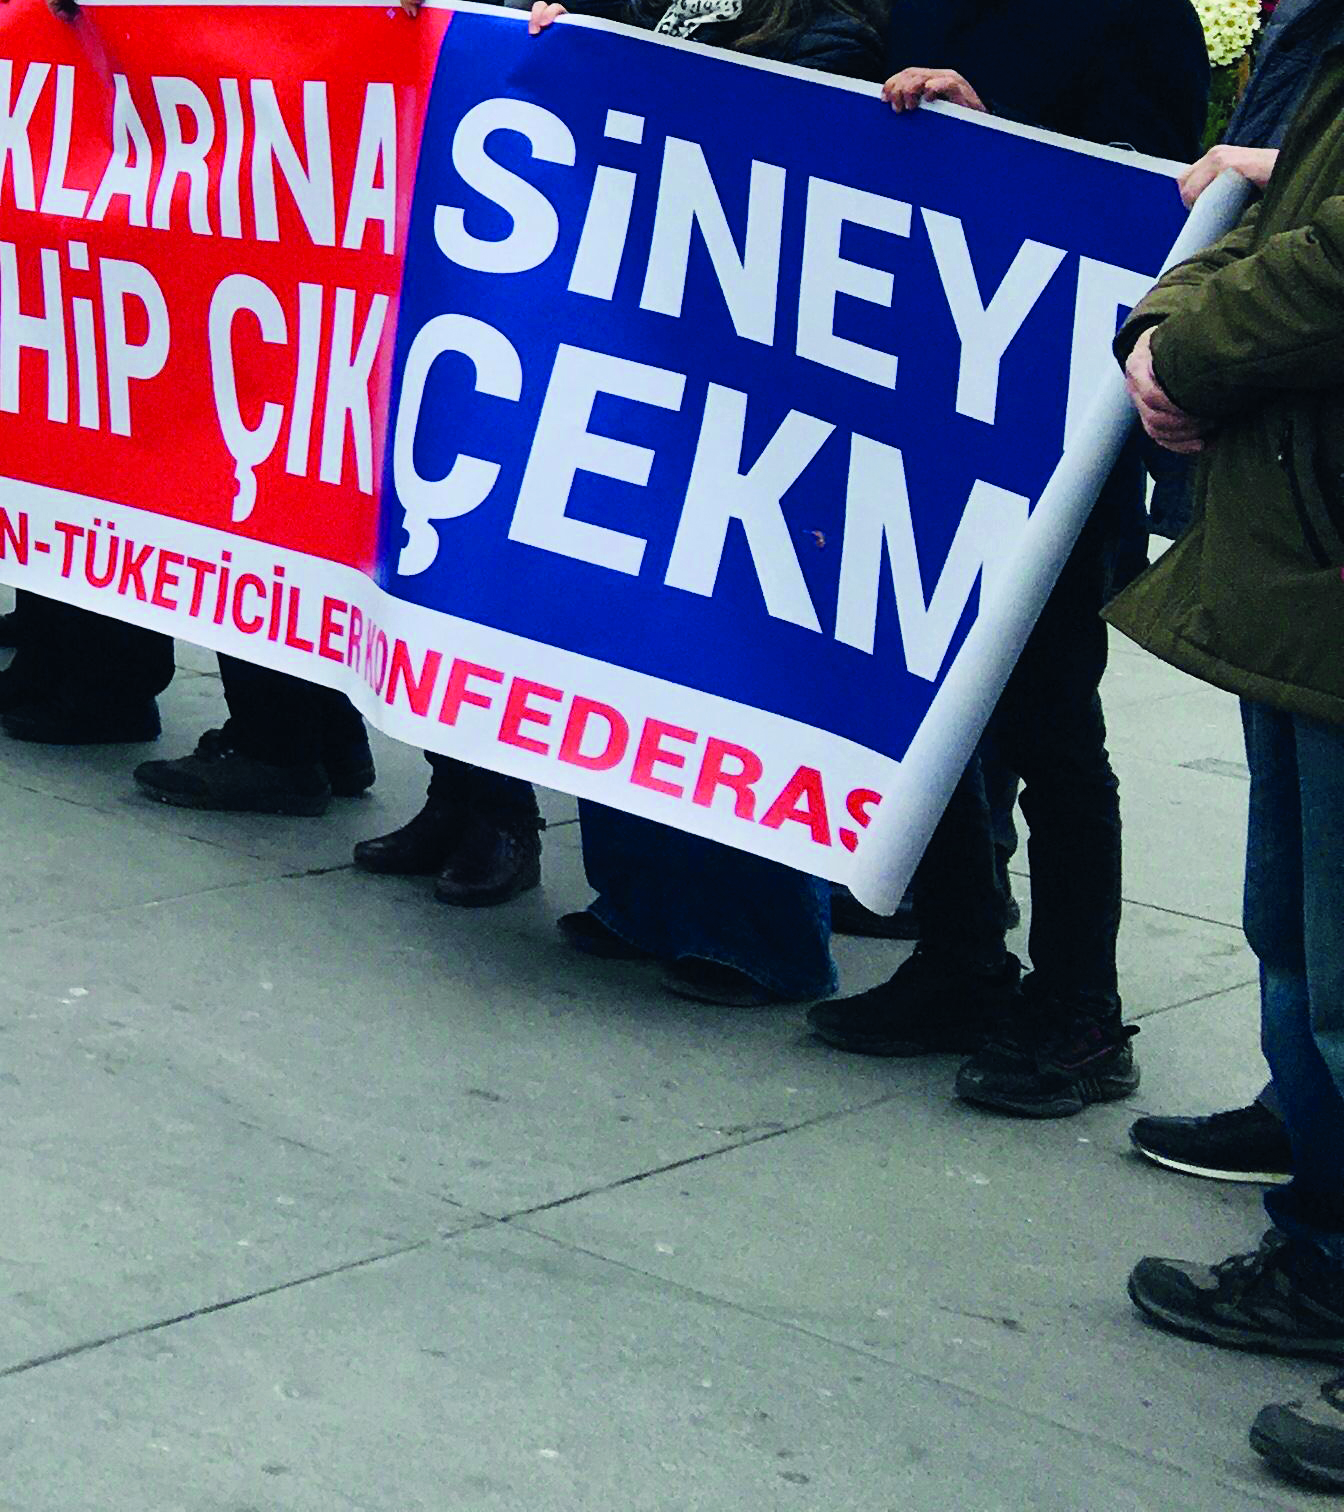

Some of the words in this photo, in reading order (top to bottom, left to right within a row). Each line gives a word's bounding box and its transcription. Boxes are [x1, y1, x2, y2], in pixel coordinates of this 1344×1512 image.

[208, 272, 391, 523] ÇIK
[394, 312, 1032, 685] ÇEKM
[365, 614, 885, 855] KONFEDERAS
